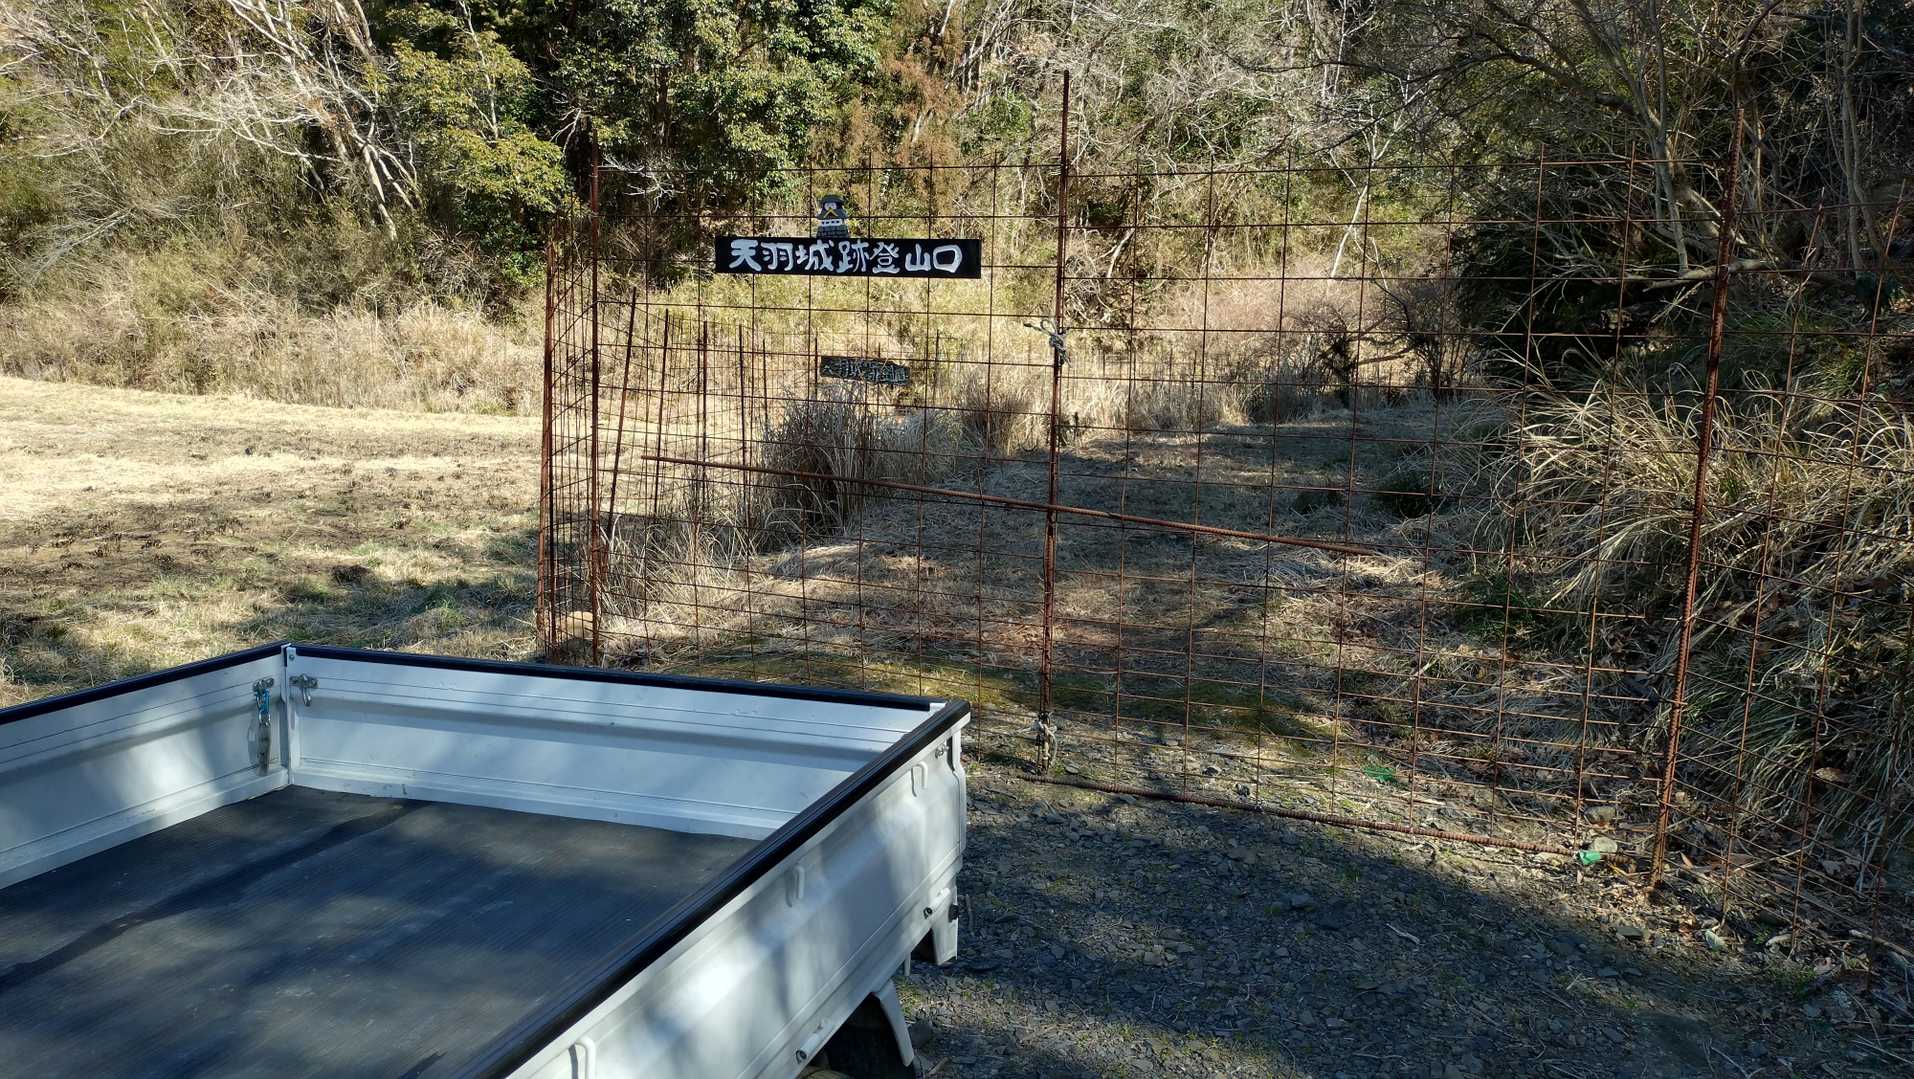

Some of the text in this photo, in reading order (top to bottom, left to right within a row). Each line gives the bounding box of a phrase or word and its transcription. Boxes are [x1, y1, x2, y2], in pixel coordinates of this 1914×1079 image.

[730, 239, 963, 274] 天羽城跡登山口
